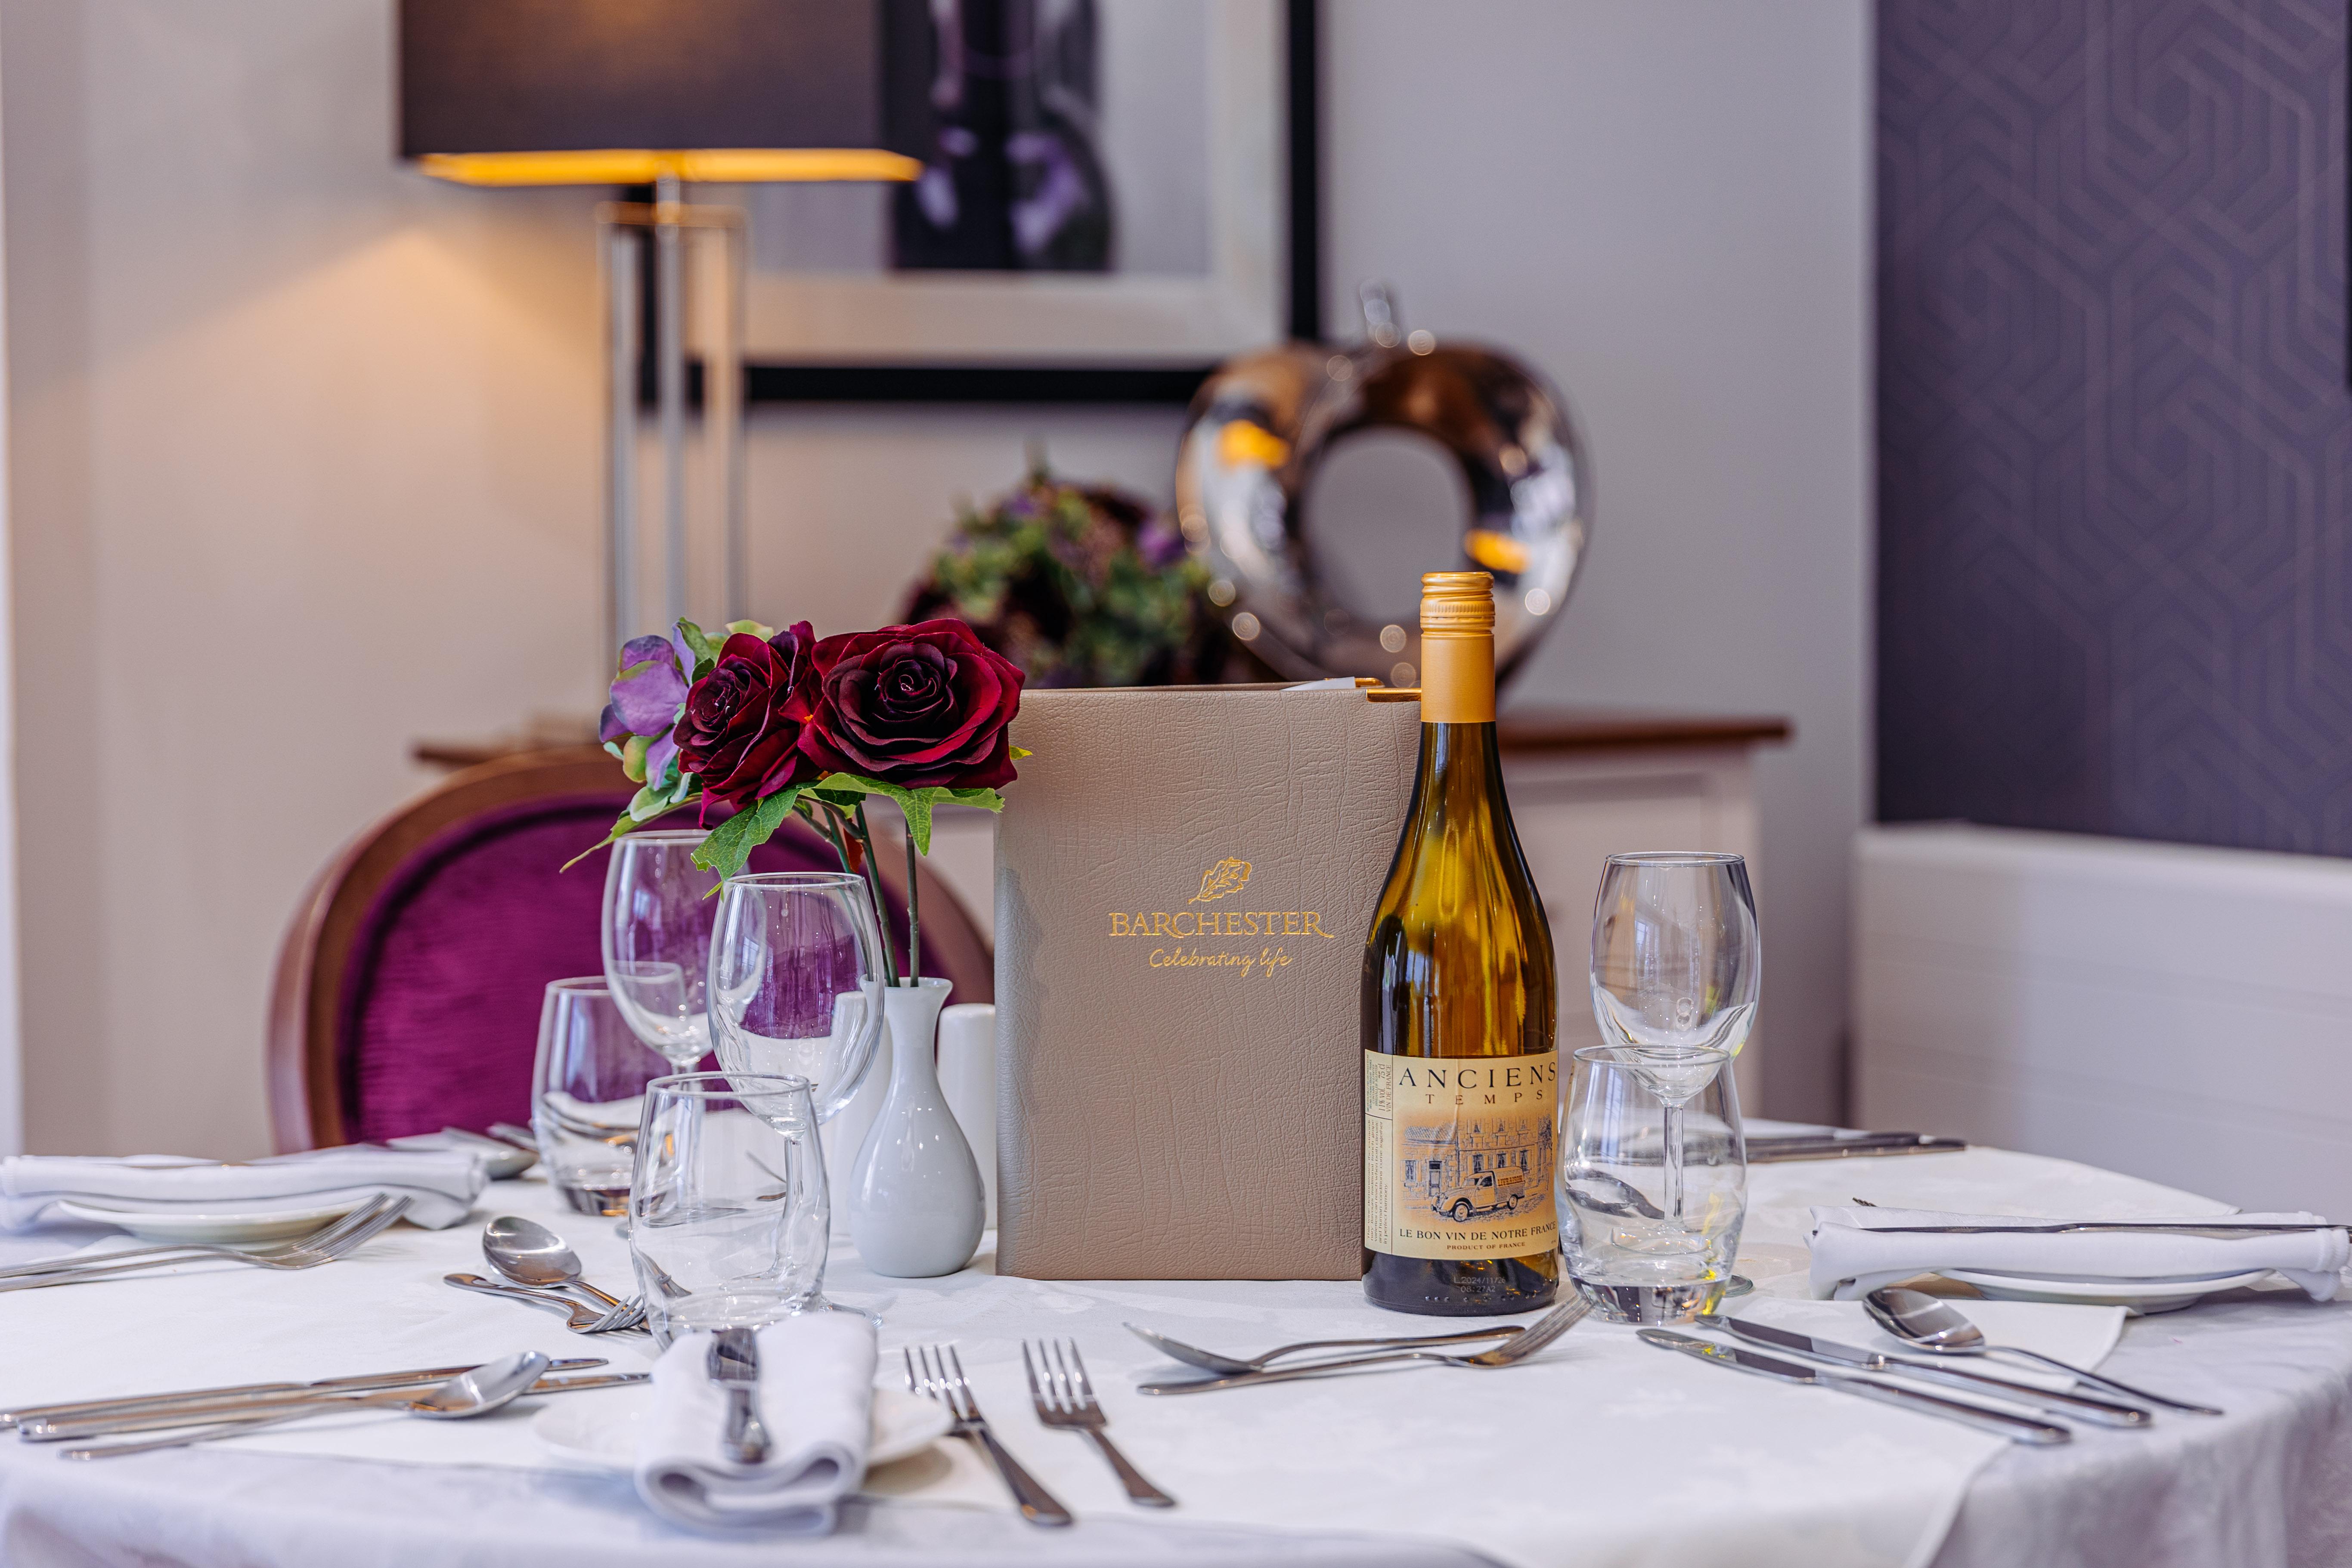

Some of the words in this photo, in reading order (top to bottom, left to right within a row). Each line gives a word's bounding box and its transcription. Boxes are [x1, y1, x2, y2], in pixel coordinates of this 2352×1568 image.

[1109, 911, 1334, 939] BARCHESTER
[1149, 947, 1256, 977] Celebrating
[1260, 947, 1293, 978] life
[1399, 1062, 1556, 1088] ANCIENS
[1386, 1092, 1391, 1100] DE
[1425, 1090, 1543, 1105] TEMPS
[1400, 1229, 1412, 1237] LE
[1417, 1230, 1441, 1240] BON
[1471, 1232, 1487, 1240] DE
[1491, 1228, 1528, 1240] NOTRE
[1531, 1221, 1556, 1235] FRANCE
